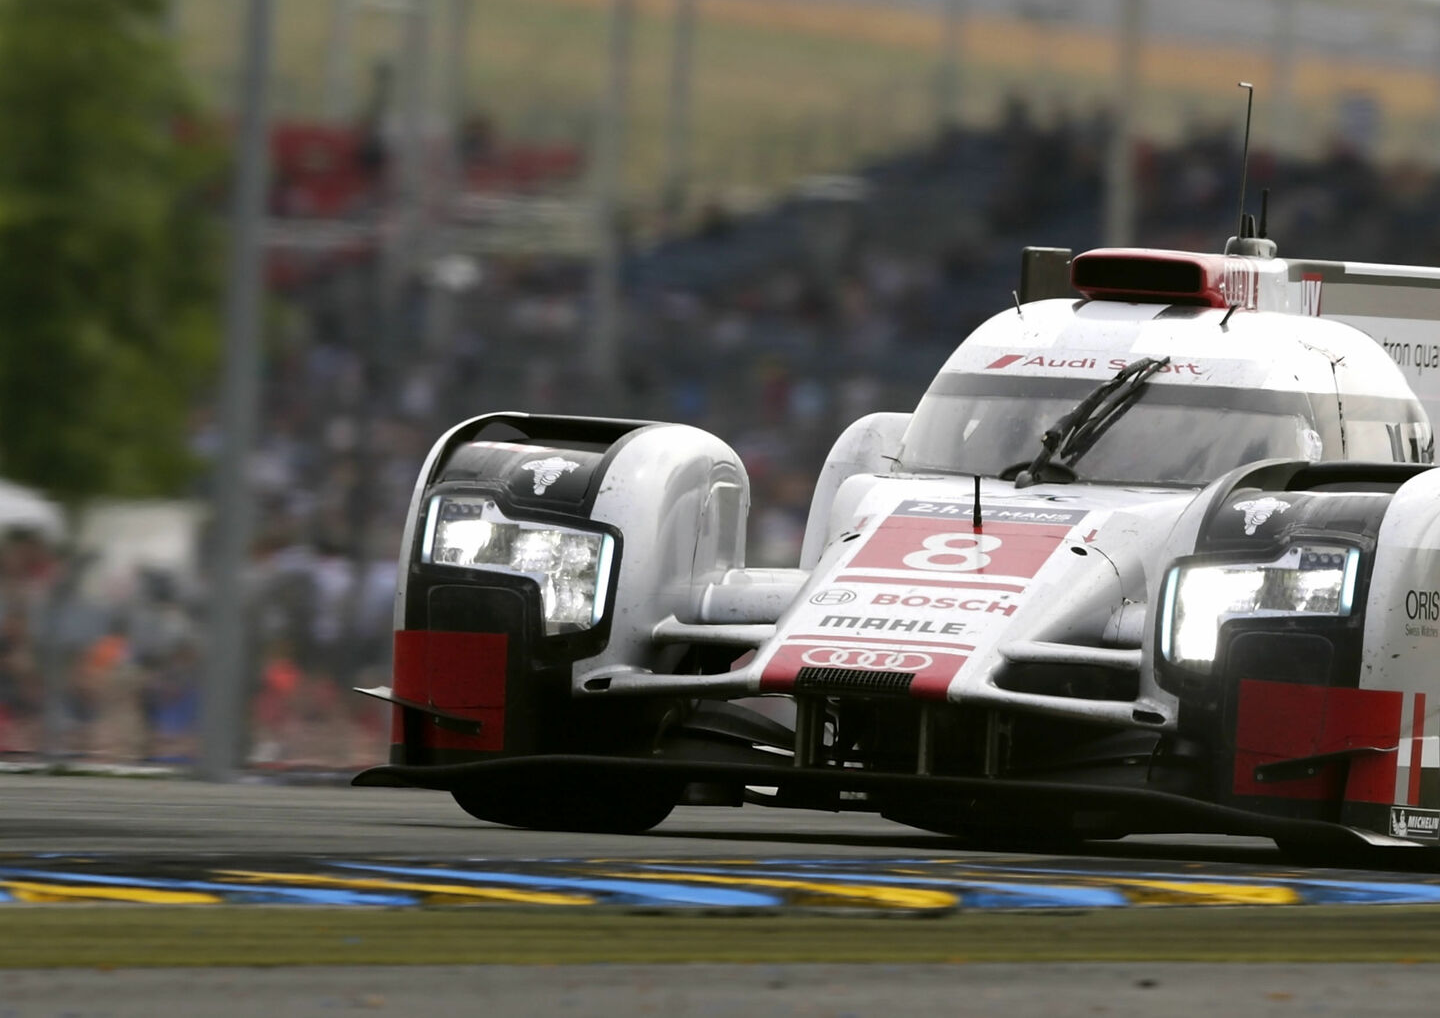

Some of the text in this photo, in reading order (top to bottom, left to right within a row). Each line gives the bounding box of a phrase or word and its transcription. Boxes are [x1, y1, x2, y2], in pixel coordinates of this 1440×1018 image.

[1023, 355, 1203, 376] Audi Sort
[997, 510, 1073, 521] MANS
[902, 532, 1003, 572] 8
[870, 593, 1019, 617] BOSCH
[1405, 589, 1440, 622] ORIS
[818, 615, 967, 636] MAHLE
[1408, 815, 1440, 830] MICHELIN
